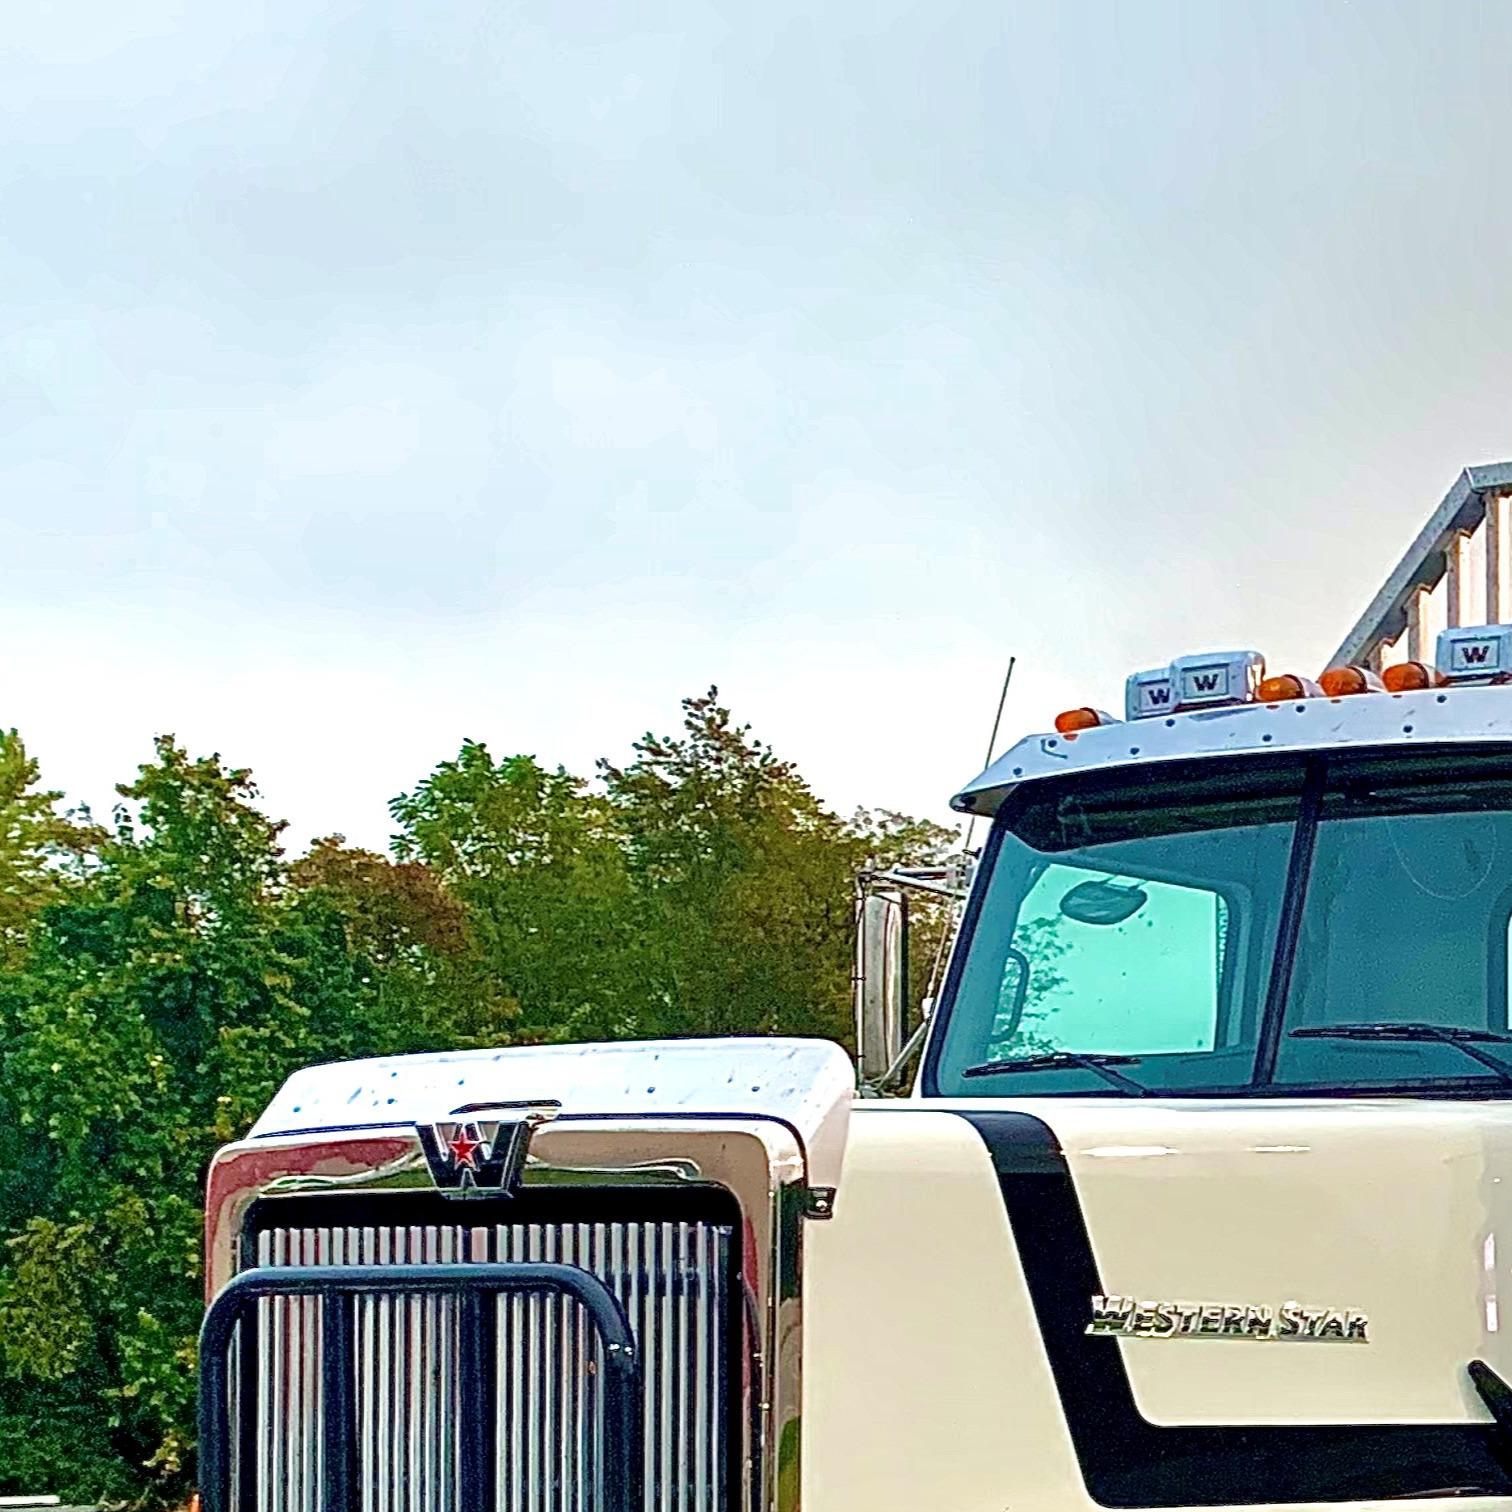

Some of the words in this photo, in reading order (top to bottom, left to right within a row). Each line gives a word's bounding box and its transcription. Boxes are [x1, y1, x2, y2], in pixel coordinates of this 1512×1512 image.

[1462, 646, 1489, 663] W
[1193, 673, 1219, 691] W
[1088, 1294, 1276, 1340] WESTERN
[1278, 1300, 1369, 1343] STAR
